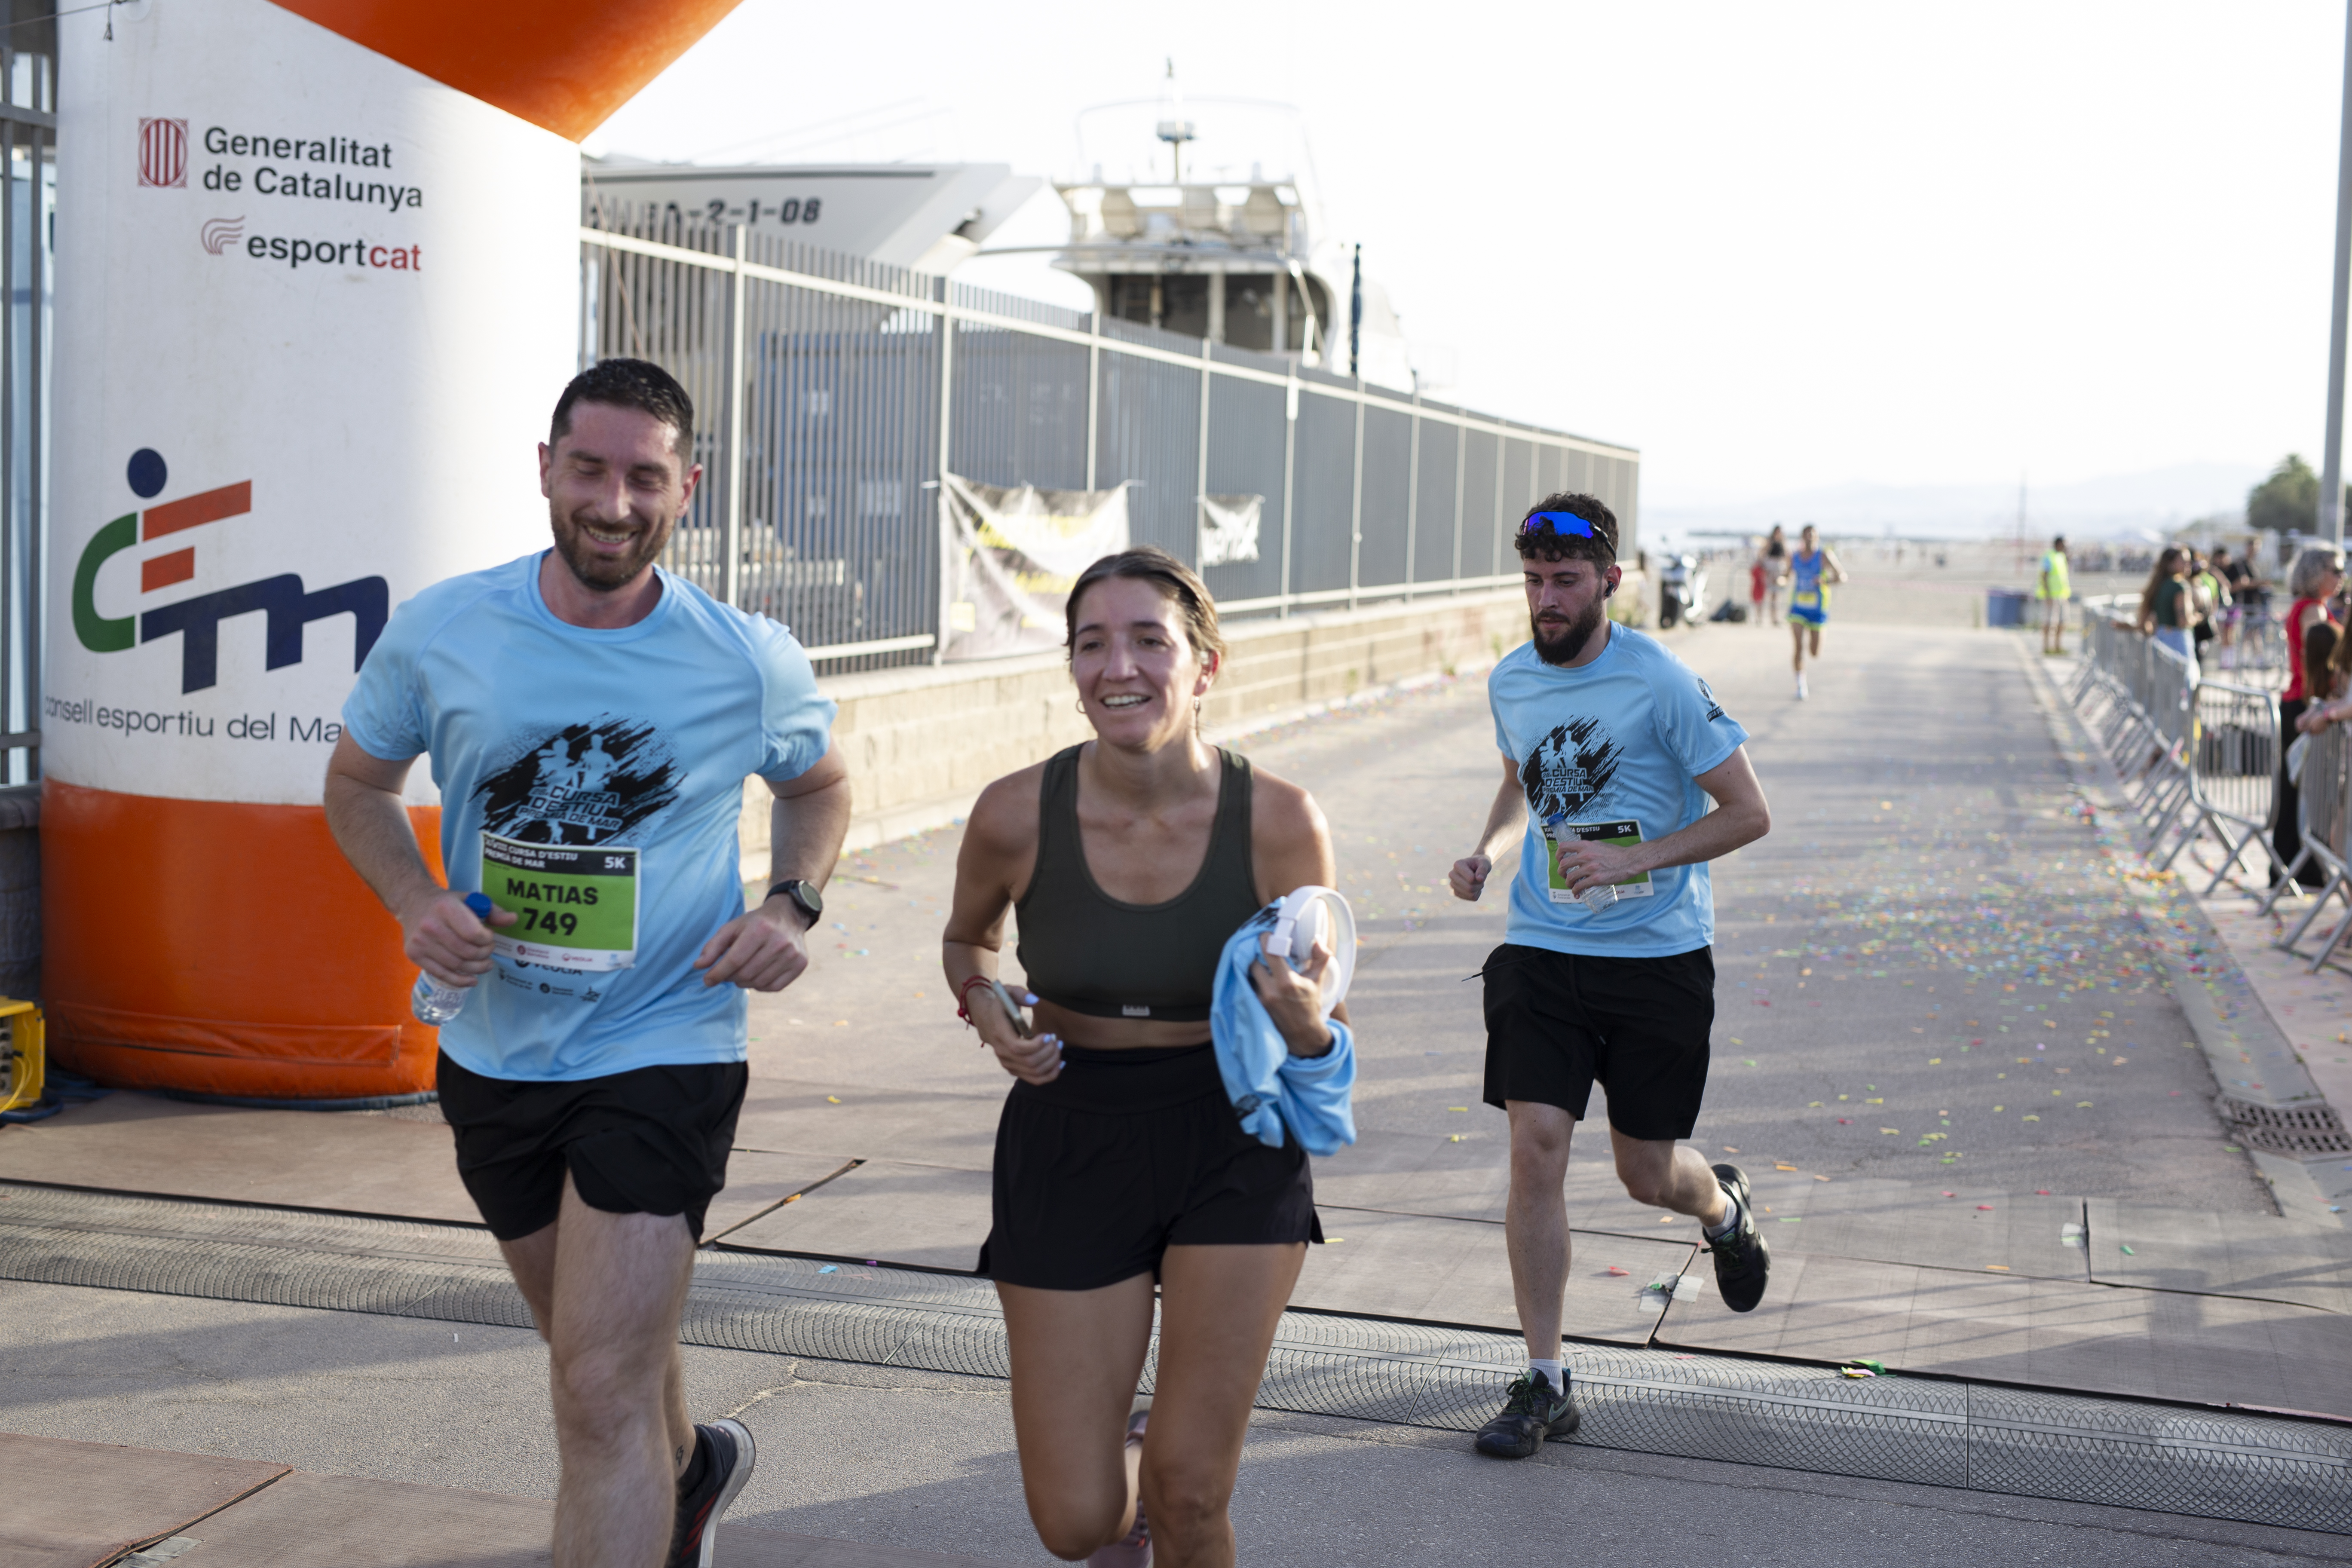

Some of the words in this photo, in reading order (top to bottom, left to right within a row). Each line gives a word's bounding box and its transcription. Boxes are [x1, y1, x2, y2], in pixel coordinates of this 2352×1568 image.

[204, 126, 392, 168] Generalitat
[203, 165, 242, 191] de
[254, 167, 423, 213] Catalunya
[247, 234, 422, 271] esportcat
[96, 706, 214, 737] esportiu
[228, 712, 275, 740] del
[290, 716, 343, 743] Ma
[1553, 769, 1586, 778] CURSA
[550, 786, 617, 805] CURSA
[569, 813, 587, 823] DE
[588, 817, 620, 828] MAR
[1617, 825, 1632, 833] 5K
[508, 845, 536, 858] CURSA
[538, 851, 578, 861] D'ESTIU
[511, 855, 523, 865] DE
[524, 860, 545, 868] MAR
[604, 857, 625, 869] 5K
[507, 878, 599, 906] MATIAS
[523, 907, 578, 936] 749
